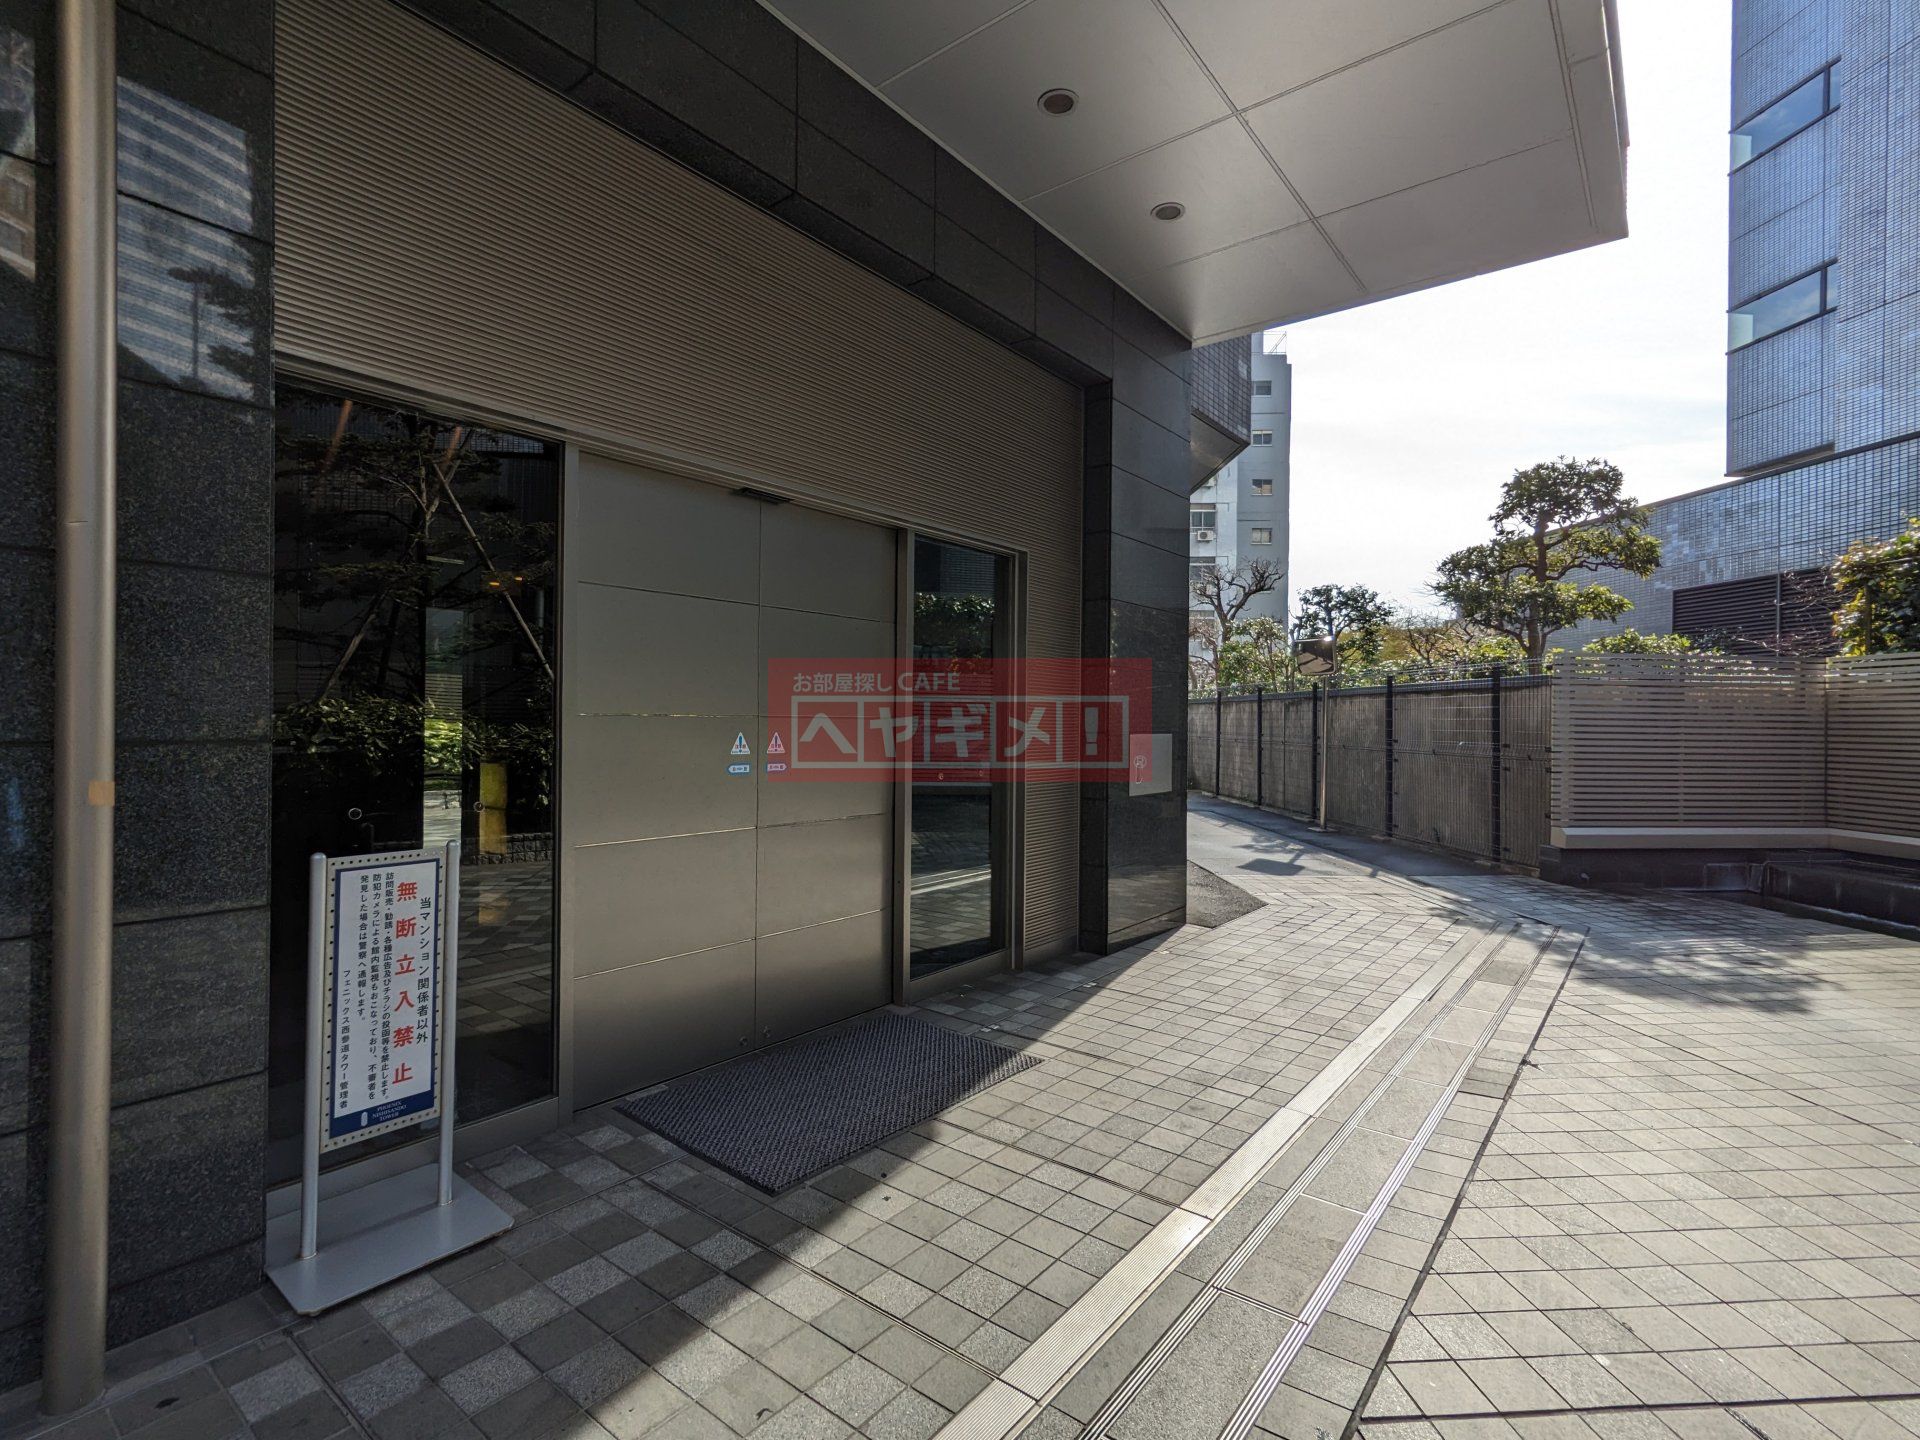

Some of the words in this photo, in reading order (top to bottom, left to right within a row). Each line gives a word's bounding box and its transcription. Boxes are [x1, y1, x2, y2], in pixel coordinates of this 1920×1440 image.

[392, 881, 417, 1084] 無断立入禁止
[416, 897, 431, 1044] 当マンション関係者以外
